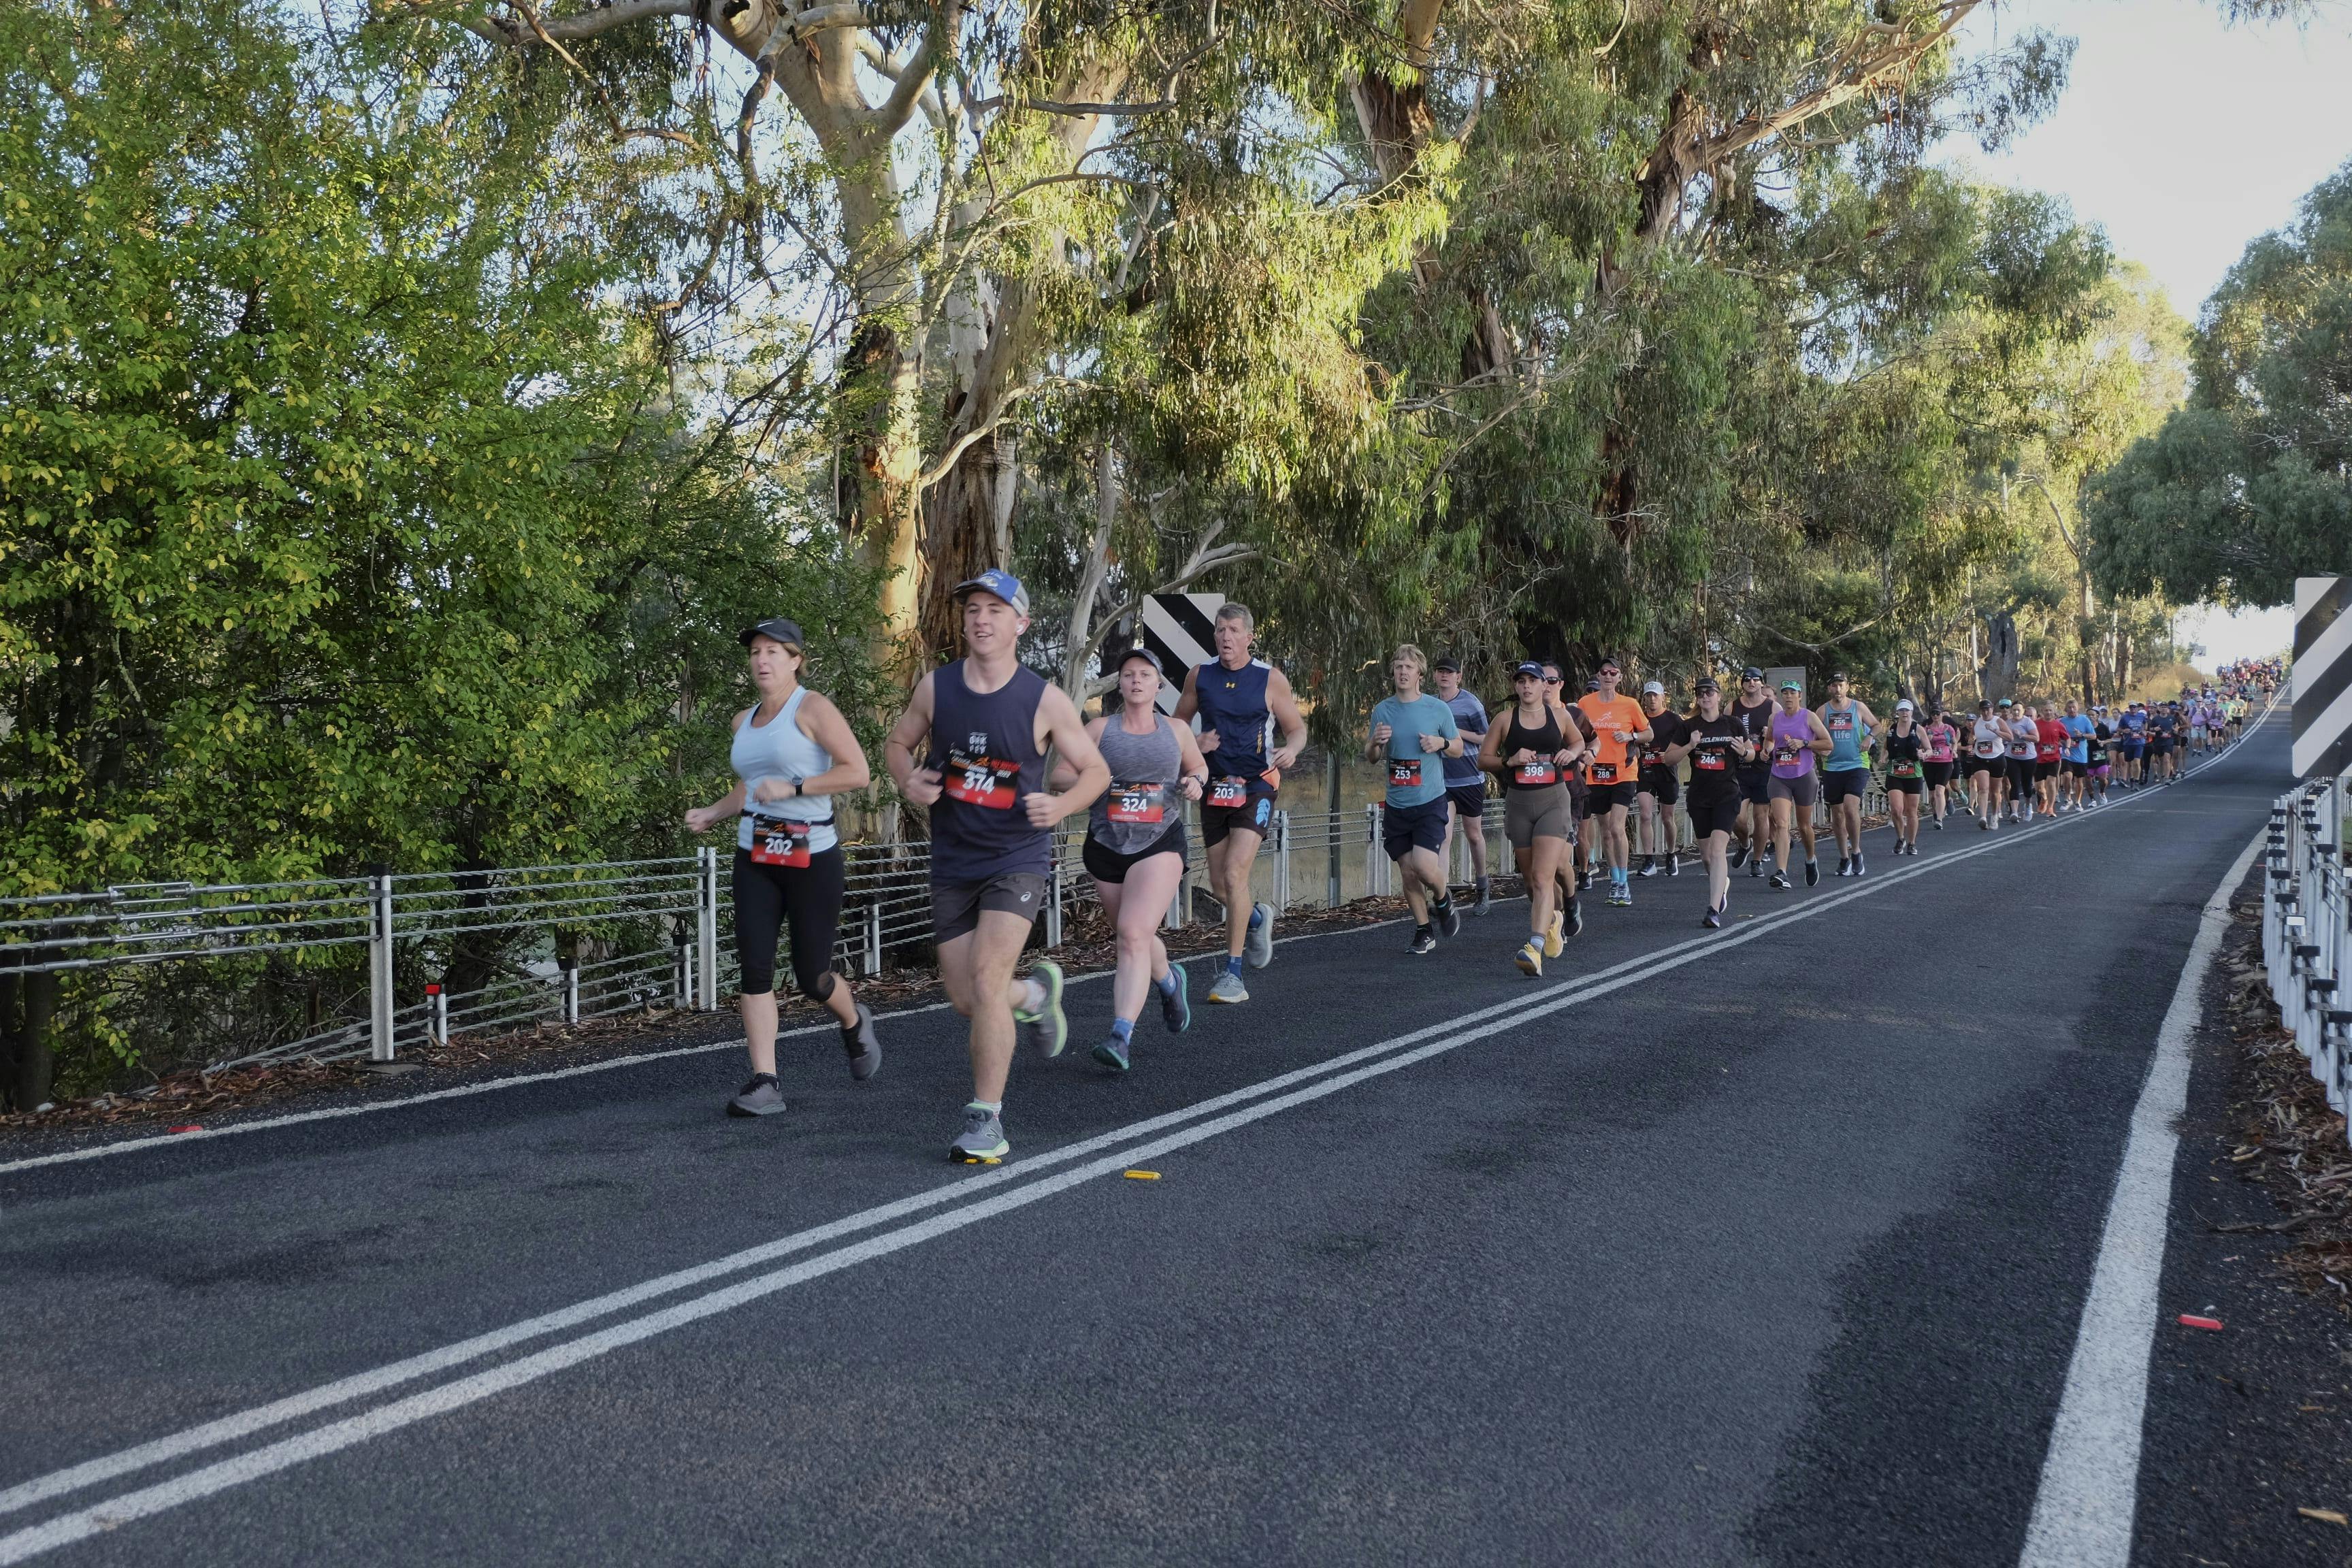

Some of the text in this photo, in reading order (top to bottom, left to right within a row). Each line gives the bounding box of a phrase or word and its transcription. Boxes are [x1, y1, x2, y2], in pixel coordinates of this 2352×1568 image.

[1701, 755, 1716, 764] 246
[1395, 770, 1411, 779] 253
[1524, 766, 1544, 777] 398
[962, 770, 995, 794] 374
[1214, 787, 1234, 800] 203
[1122, 798, 1147, 813] 324
[765, 838, 794, 856] 202
